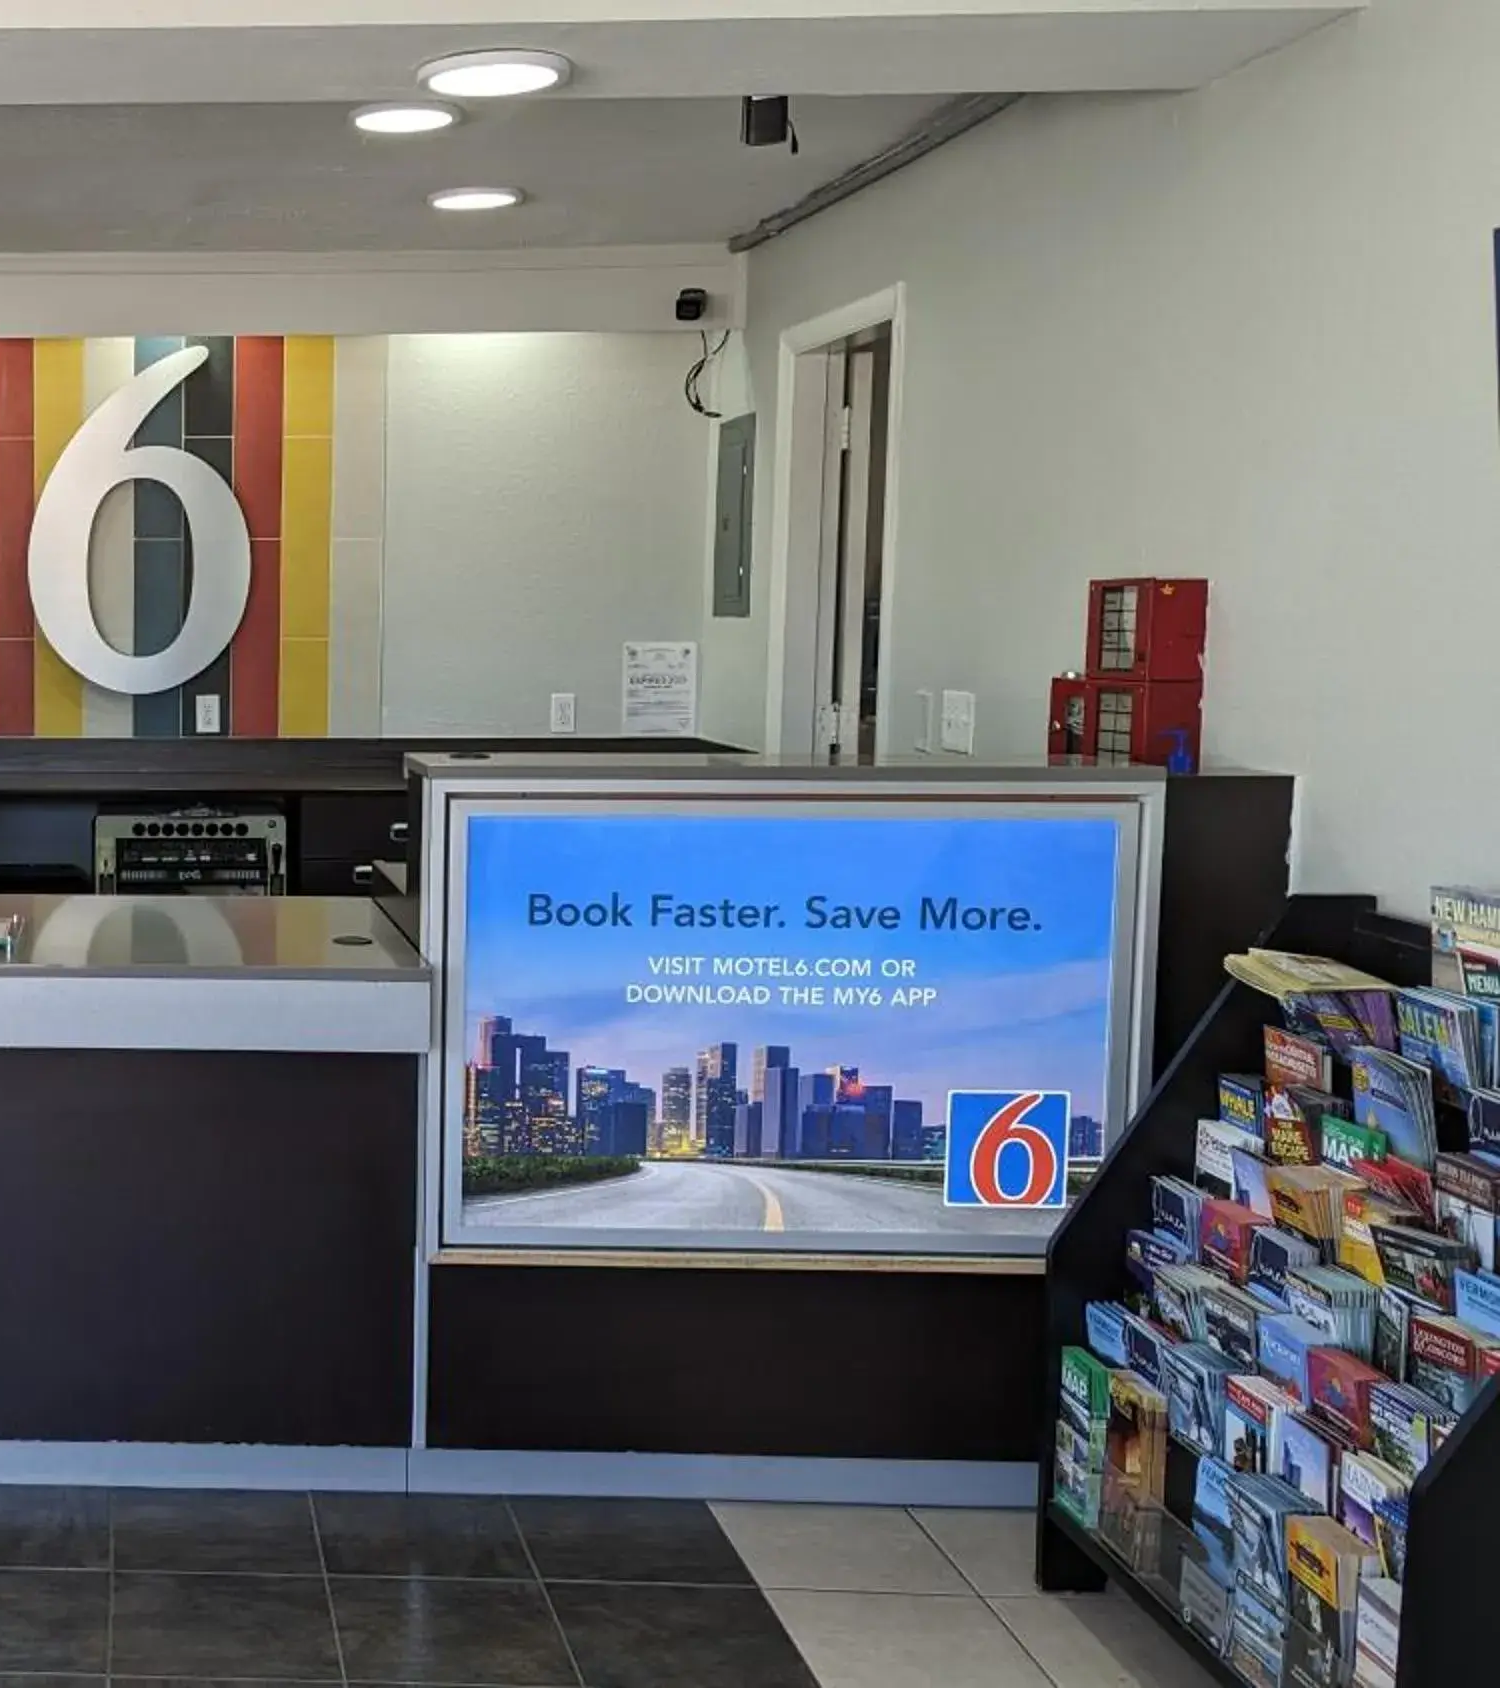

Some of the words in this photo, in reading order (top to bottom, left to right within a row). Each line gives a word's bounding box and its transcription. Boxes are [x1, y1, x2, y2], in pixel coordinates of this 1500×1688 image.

[28, 344, 251, 694] 6
[528, 892, 633, 928] Book
[651, 894, 786, 930] Faster.
[805, 896, 901, 931] Save
[920, 897, 1043, 932] More.
[648, 956, 706, 976] VISIT
[713, 957, 872, 978] MOTEL6.COM
[881, 959, 916, 978] OR
[626, 984, 771, 1006] DOWNLOAD
[779, 986, 825, 1006] THE
[833, 987, 881, 1007] MY6
[890, 988, 937, 1008] APP
[970, 1090, 1057, 1208] 6
